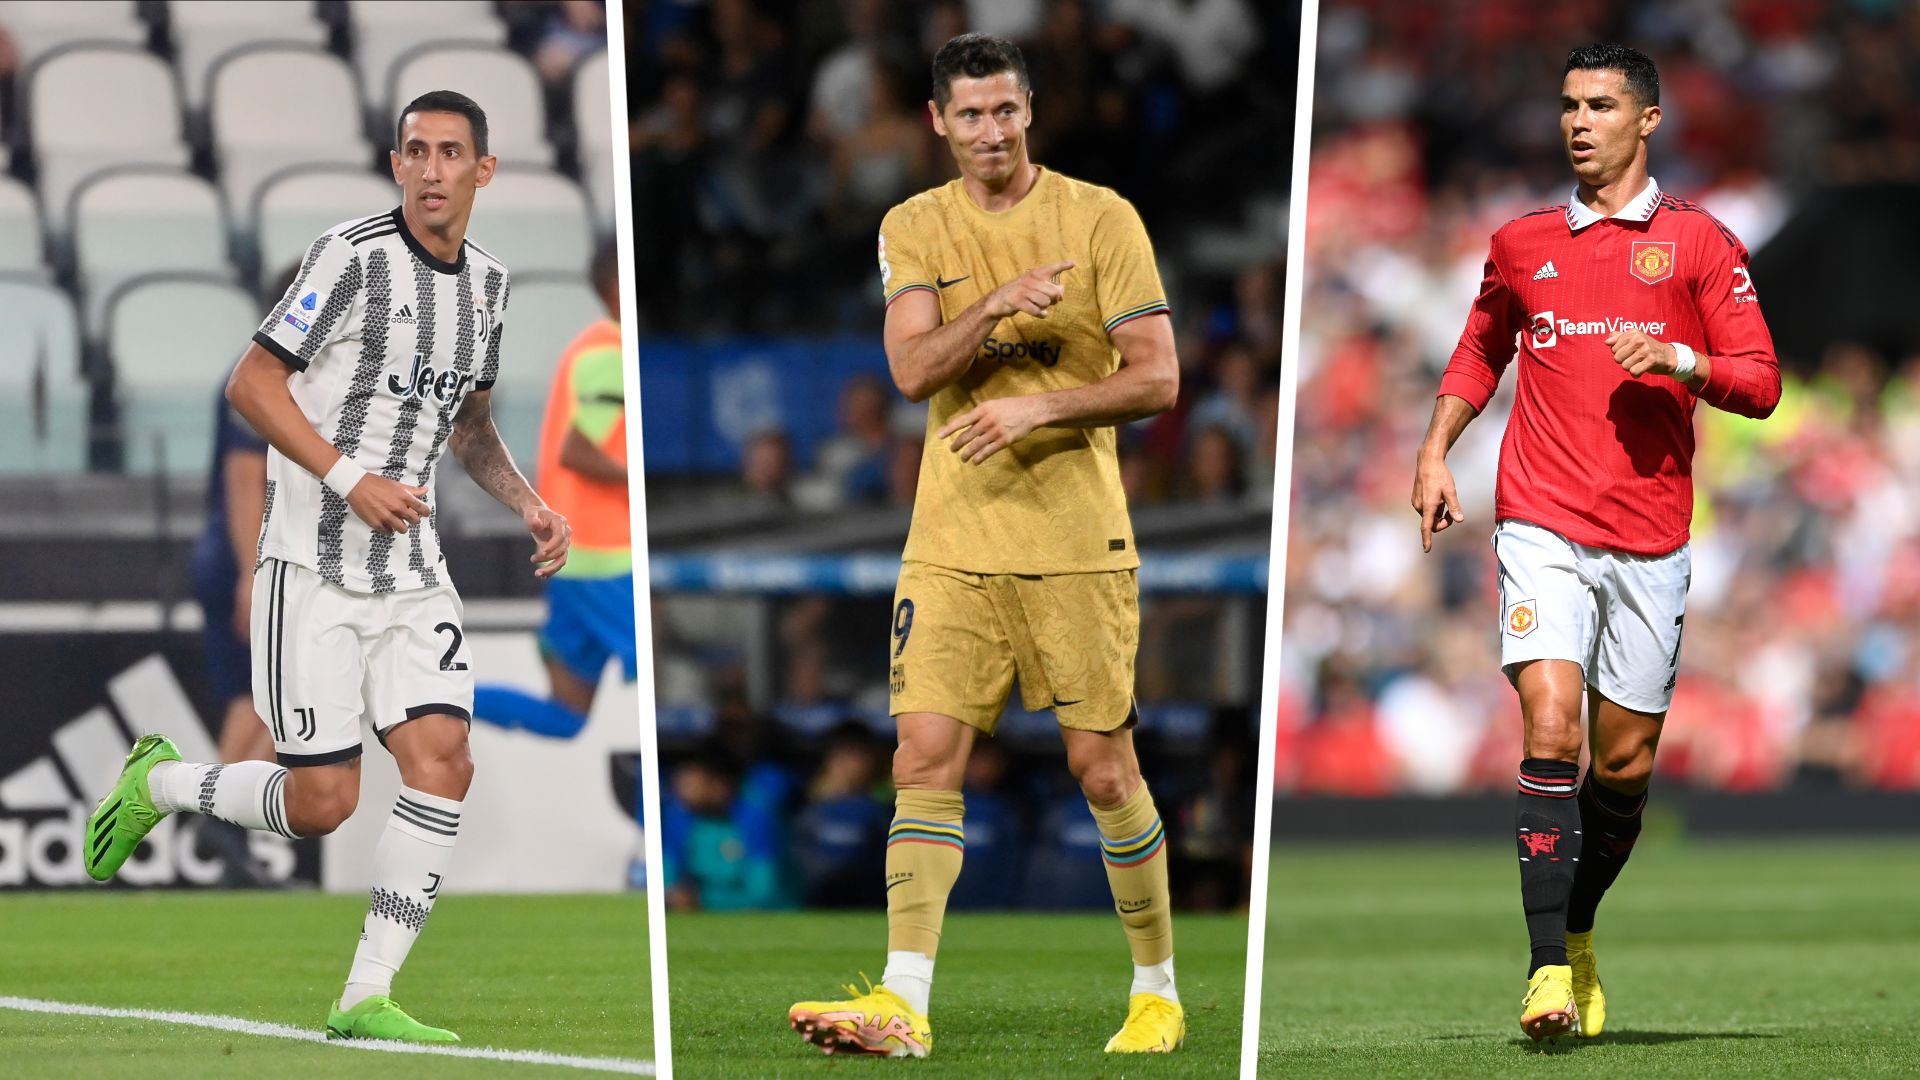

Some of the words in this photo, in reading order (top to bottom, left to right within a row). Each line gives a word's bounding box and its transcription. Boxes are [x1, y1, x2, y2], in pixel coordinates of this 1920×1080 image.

[1533, 271, 1559, 281] adidas
[294, 319, 306, 330] TIM
[391, 317, 417, 325] adidas
[1556, 317, 1666, 336] TeamViewer
[894, 598, 914, 657] 9
[1669, 614, 1685, 668] 7
[433, 622, 469, 671] 2
[0, 803, 298, 886] ddas
